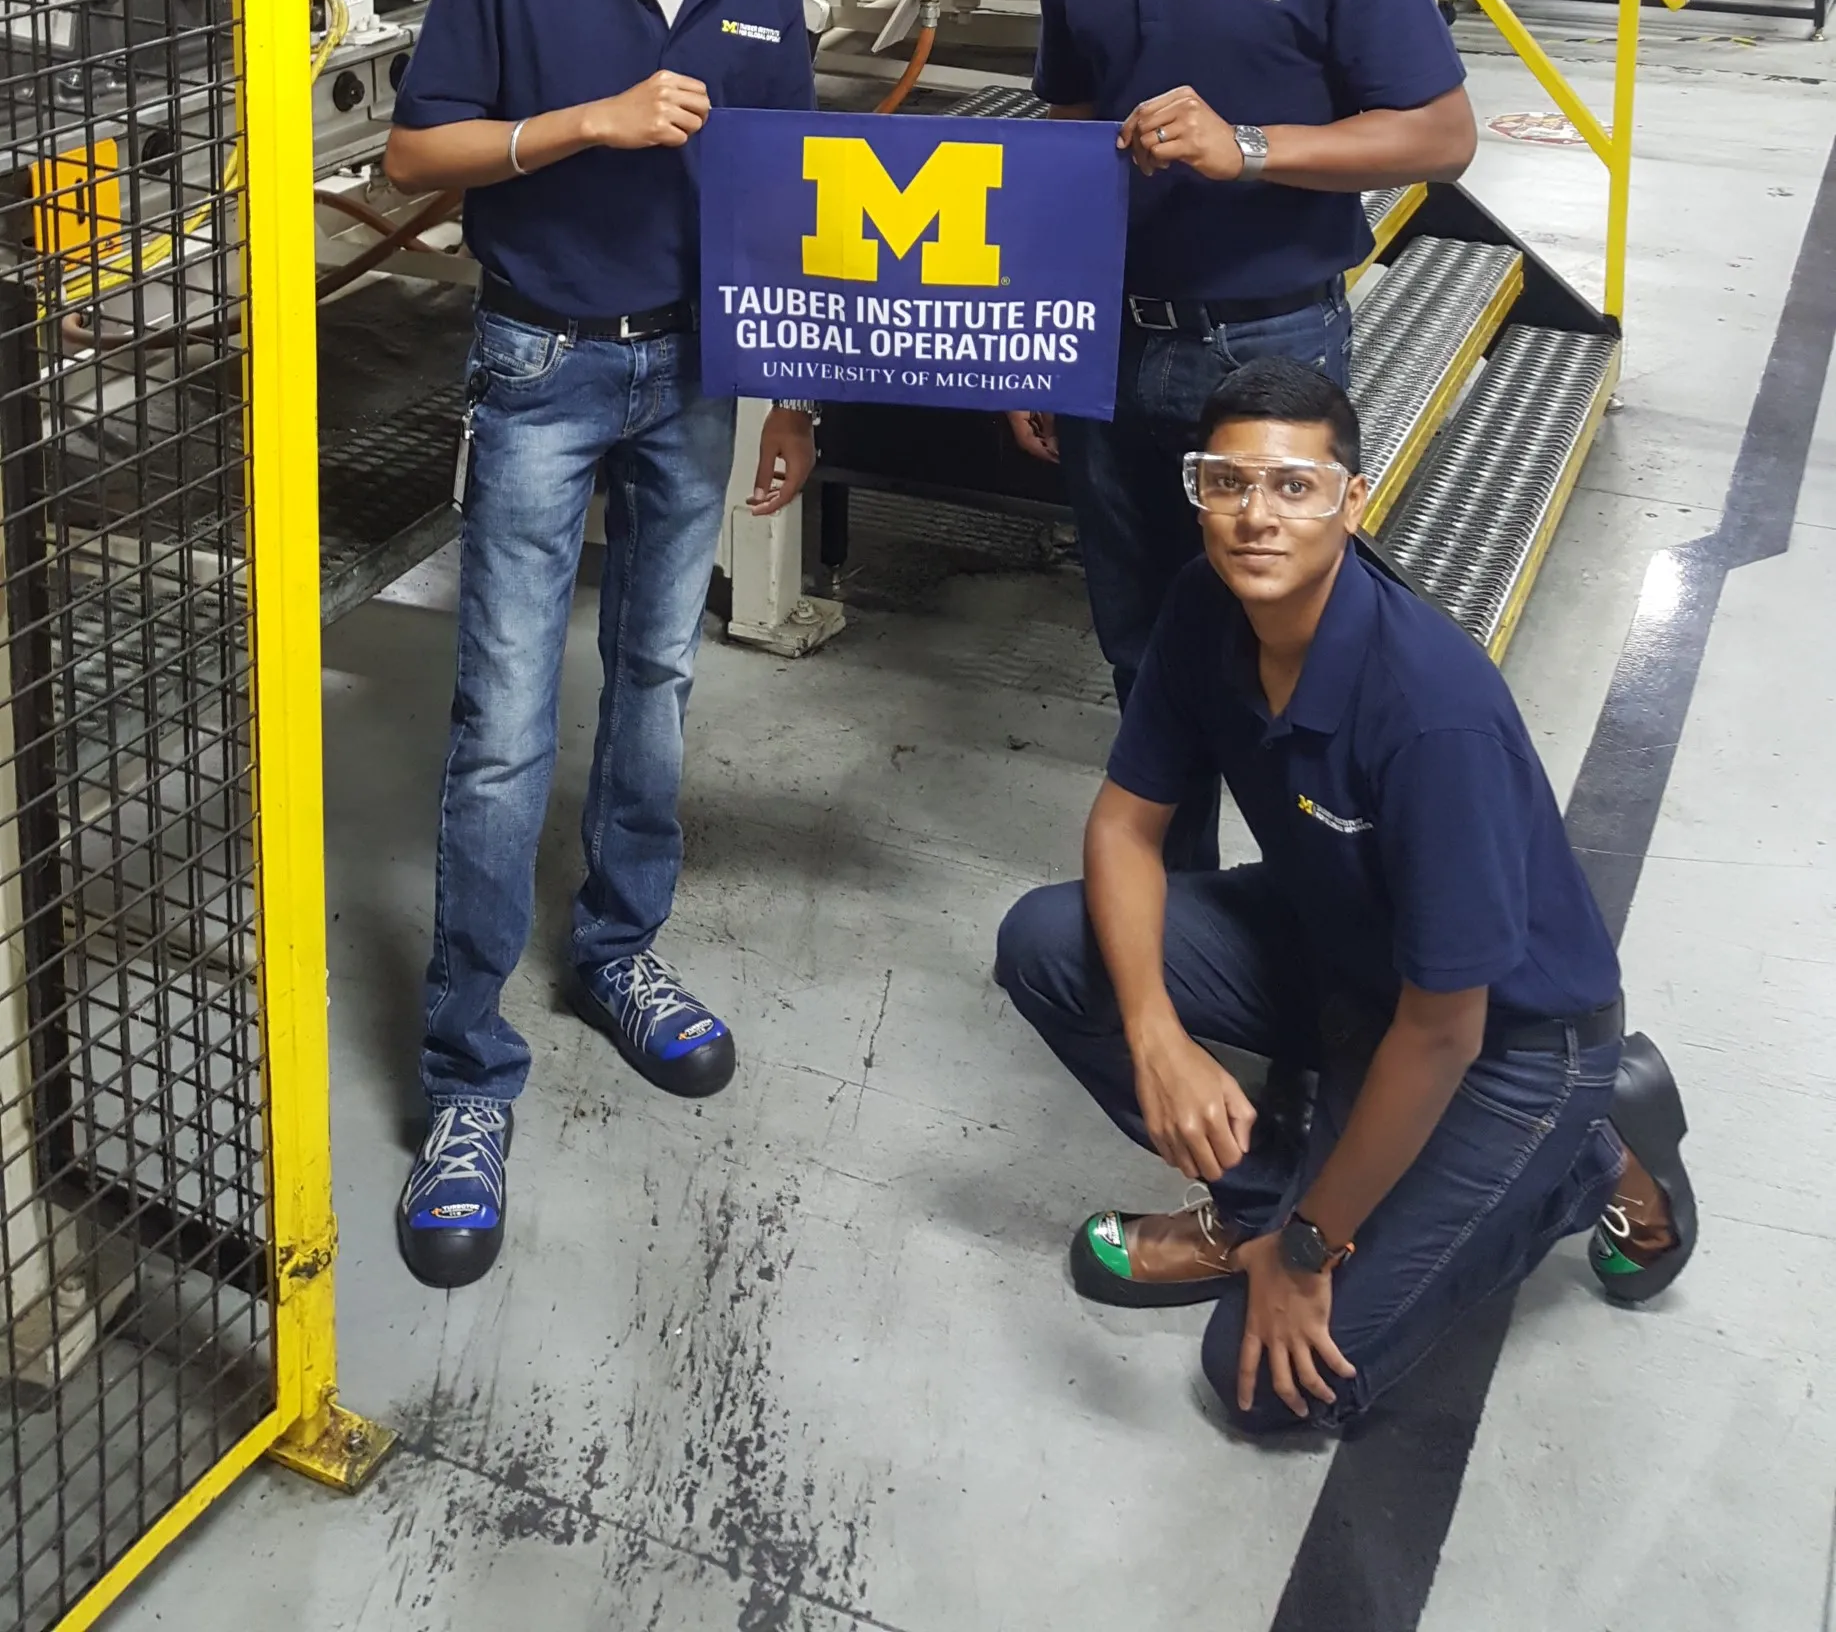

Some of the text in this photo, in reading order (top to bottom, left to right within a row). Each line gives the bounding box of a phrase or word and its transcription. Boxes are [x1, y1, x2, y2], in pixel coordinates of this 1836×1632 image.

[721, 19, 738, 34] M
[802, 135, 1004, 287] M
[719, 285, 1097, 332] TAUBER INSTITUTE FOR
[736, 318, 1079, 364] GLOBAL OPERATIONS
[762, 361, 1053, 392] UNIVERSITY OF MICHIGAN
